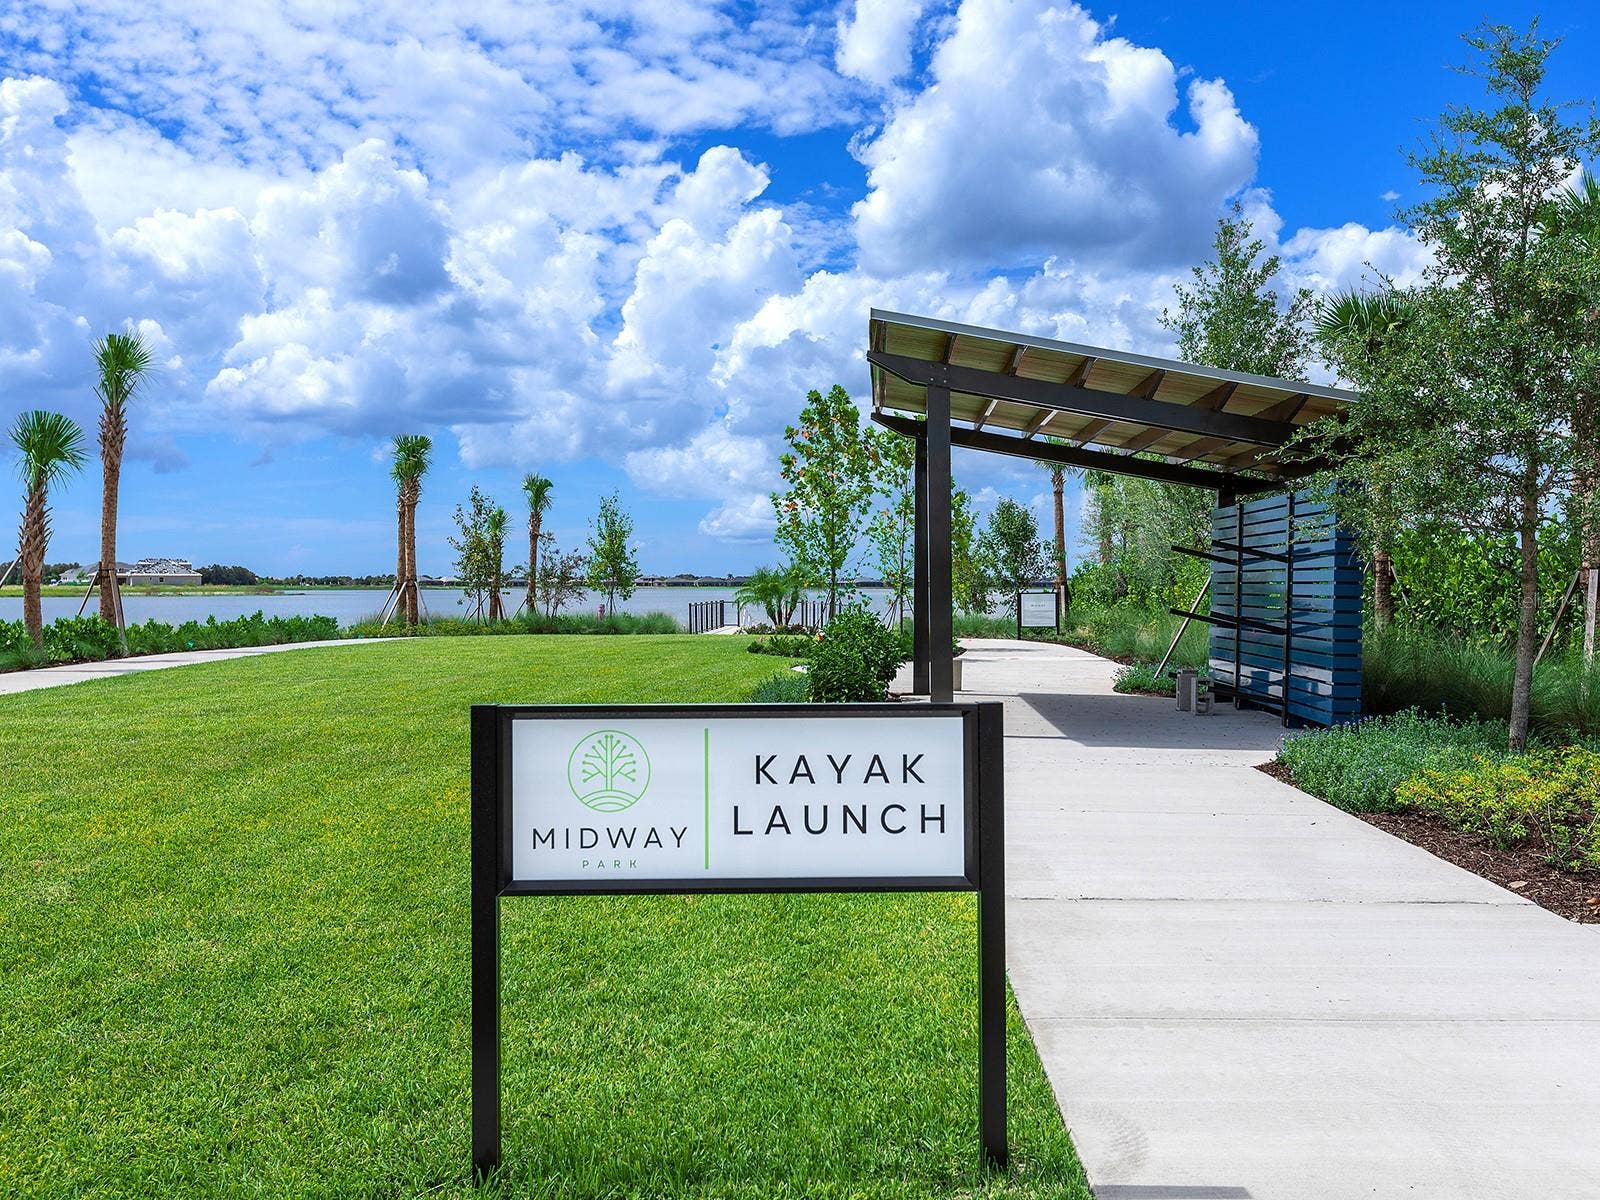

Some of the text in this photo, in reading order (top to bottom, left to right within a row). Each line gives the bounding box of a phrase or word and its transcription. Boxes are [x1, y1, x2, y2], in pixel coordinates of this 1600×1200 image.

[755, 753, 926, 785] KAYAK
[733, 803, 946, 836] LAUNCH
[532, 826, 688, 850] MIDWAY
[582, 859, 637, 869] PARK
